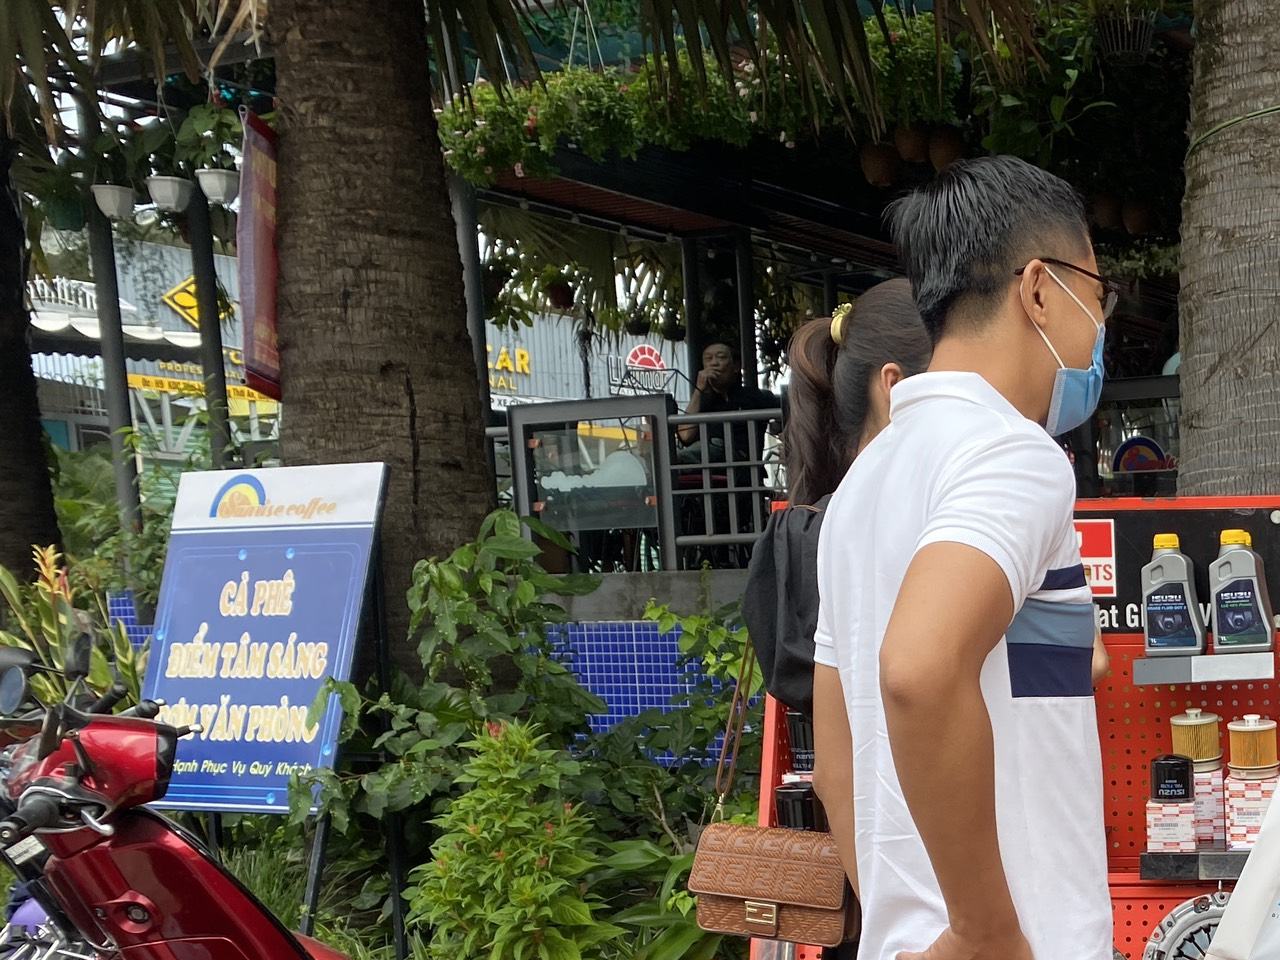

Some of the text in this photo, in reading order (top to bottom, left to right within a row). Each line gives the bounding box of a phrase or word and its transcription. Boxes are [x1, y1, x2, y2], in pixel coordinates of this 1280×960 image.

[250, 568, 296, 617] PHÊ
[1151, 594, 1182, 602] ISUZU
[1220, 591, 1251, 600] ISUZU
[219, 631, 269, 679] TÂM
[266, 632, 329, 680] SÁNG
[200, 760, 228, 776] Phục
[231, 761, 246, 777] Vụ
[249, 761, 273, 778] Quý
[1158, 788, 1185, 796] ISUZU
